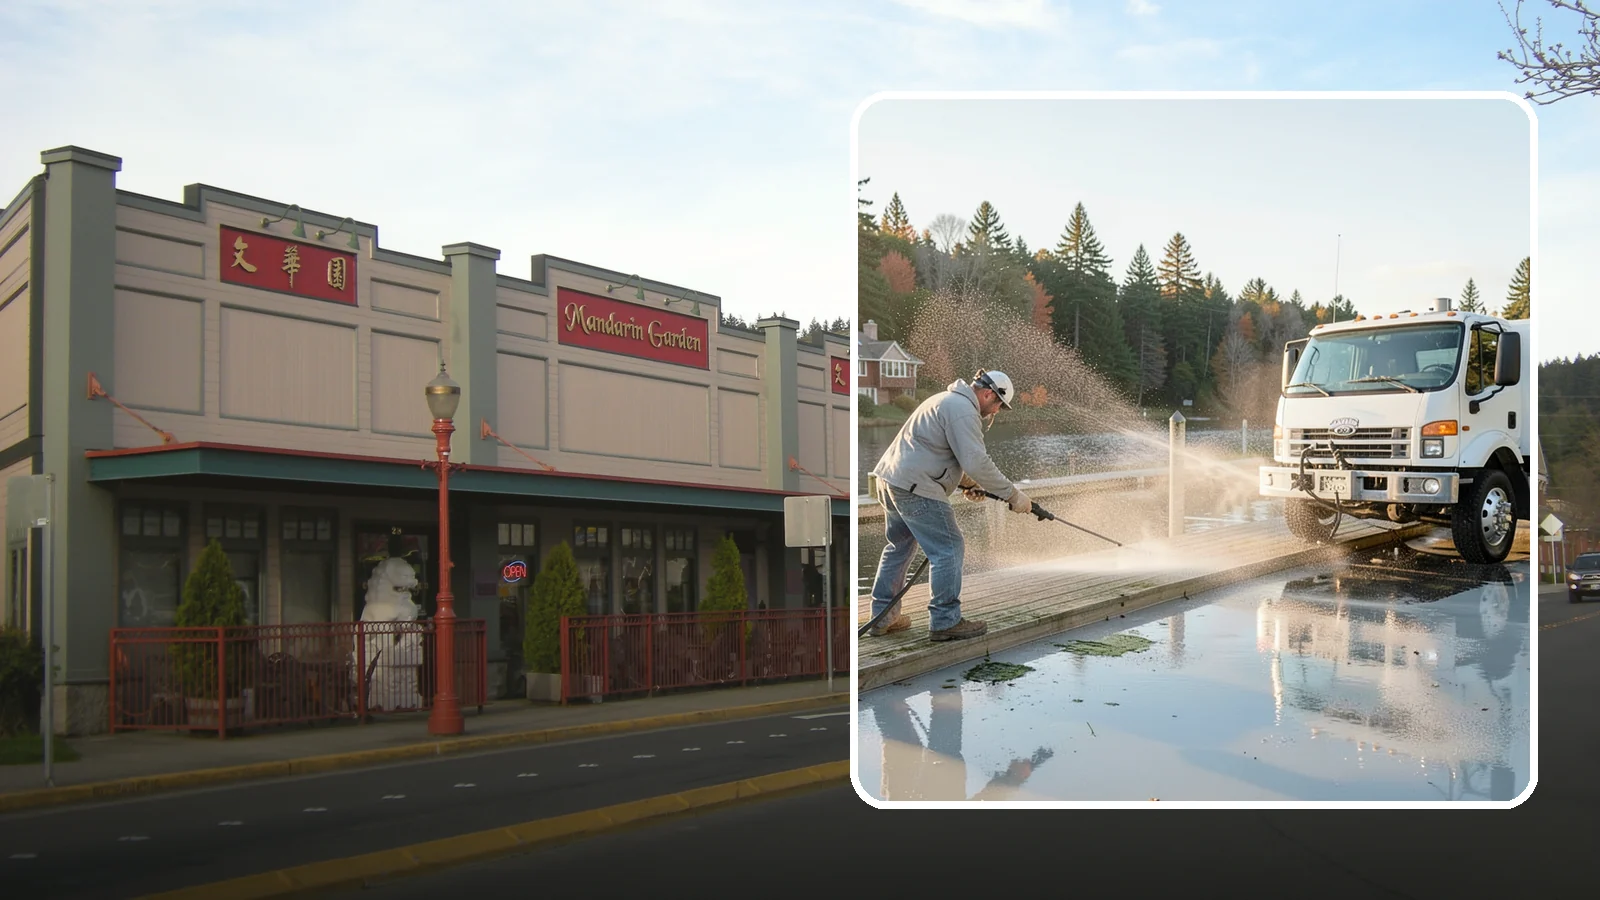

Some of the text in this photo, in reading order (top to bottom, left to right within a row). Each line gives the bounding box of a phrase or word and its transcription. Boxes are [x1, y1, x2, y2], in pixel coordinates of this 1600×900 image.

[230, 235, 346, 291] 文華園
[564, 302, 702, 352] Mandarin Garden
[503, 565, 527, 578] OPEN
